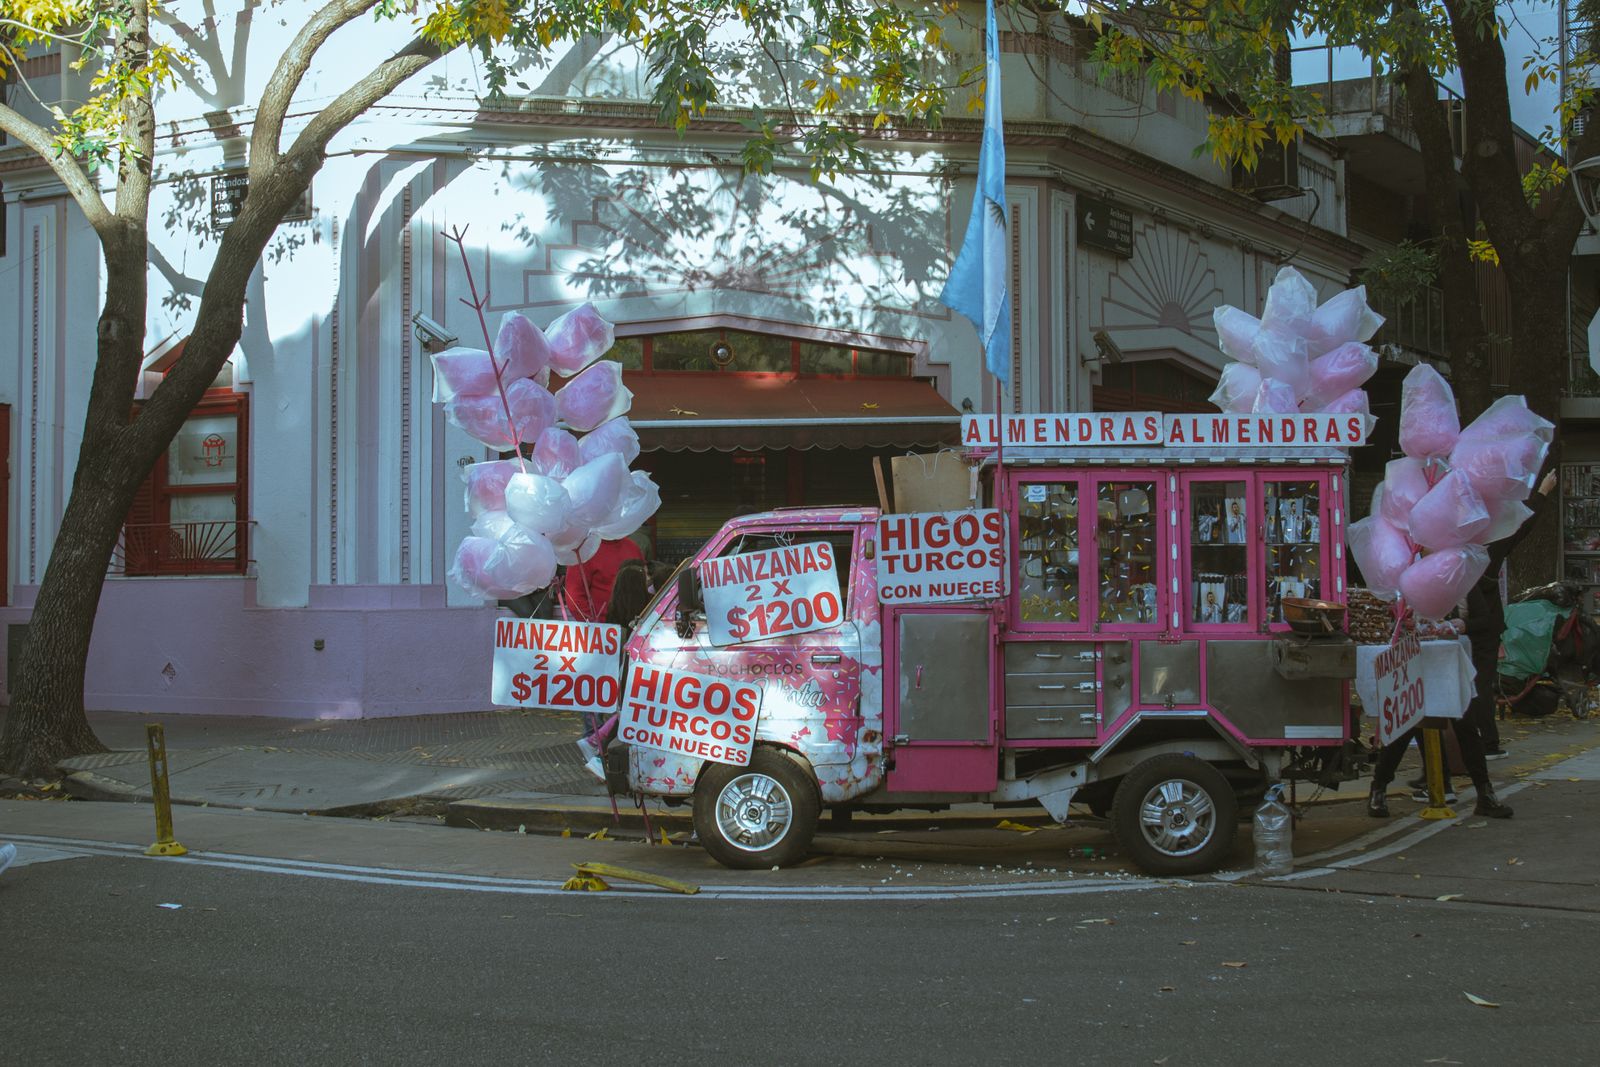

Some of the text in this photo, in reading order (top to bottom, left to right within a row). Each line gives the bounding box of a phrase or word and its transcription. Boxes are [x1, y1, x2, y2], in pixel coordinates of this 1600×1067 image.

[966, 417, 1158, 443] ALMENDRAS
[1169, 417, 1361, 443] ALMENDRAS
[880, 512, 1005, 552] HIGOS
[703, 543, 833, 588] MANZANAS
[882, 548, 1006, 574] TURCOS
[745, 585, 763, 602] 2
[881, 580, 1006, 599] CON NUECES
[727, 591, 839, 641] $1200
[496, 620, 618, 655] MANZANAS
[534, 654, 549, 671] 2
[708, 663, 803, 676] POCHOCLOS
[1375, 633, 1421, 680] MANZANAS
[511, 671, 618, 707] $1200
[630, 666, 758, 721] HIGOS
[1392, 670, 1400, 692] 2
[628, 702, 752, 745] TURCOS
[1383, 676, 1424, 739] $1200
[623, 726, 748, 764] CON NUECES
